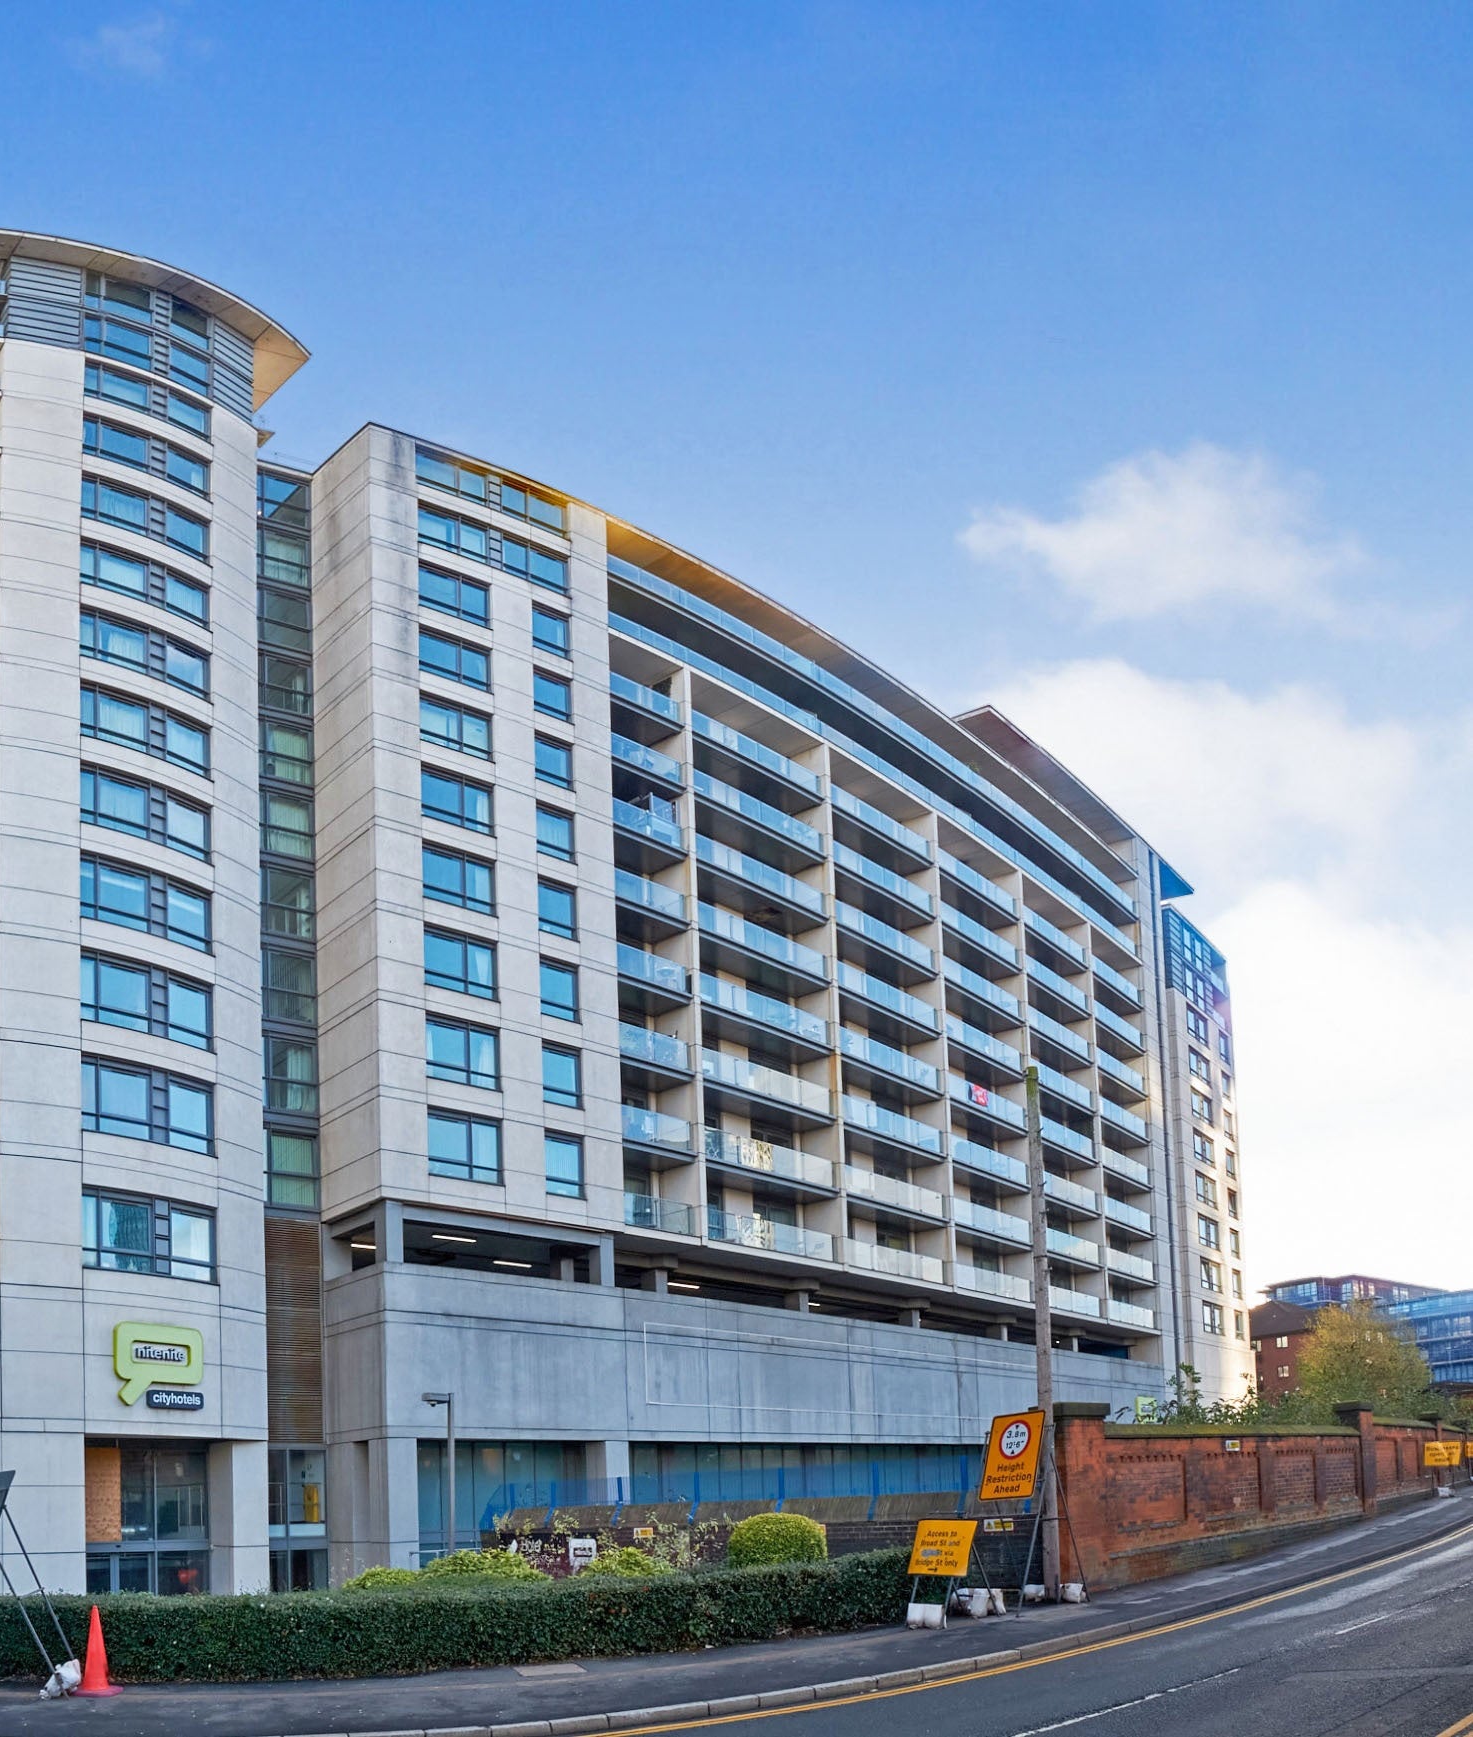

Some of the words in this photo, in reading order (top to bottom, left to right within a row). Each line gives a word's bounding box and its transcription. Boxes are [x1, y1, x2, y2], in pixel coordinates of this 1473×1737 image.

[152, 1391, 201, 1406] cityhotels
[997, 1462, 1024, 1472] Height
[986, 1473, 1032, 1484] Restriction
[994, 1484, 1020, 1494] Ahead
